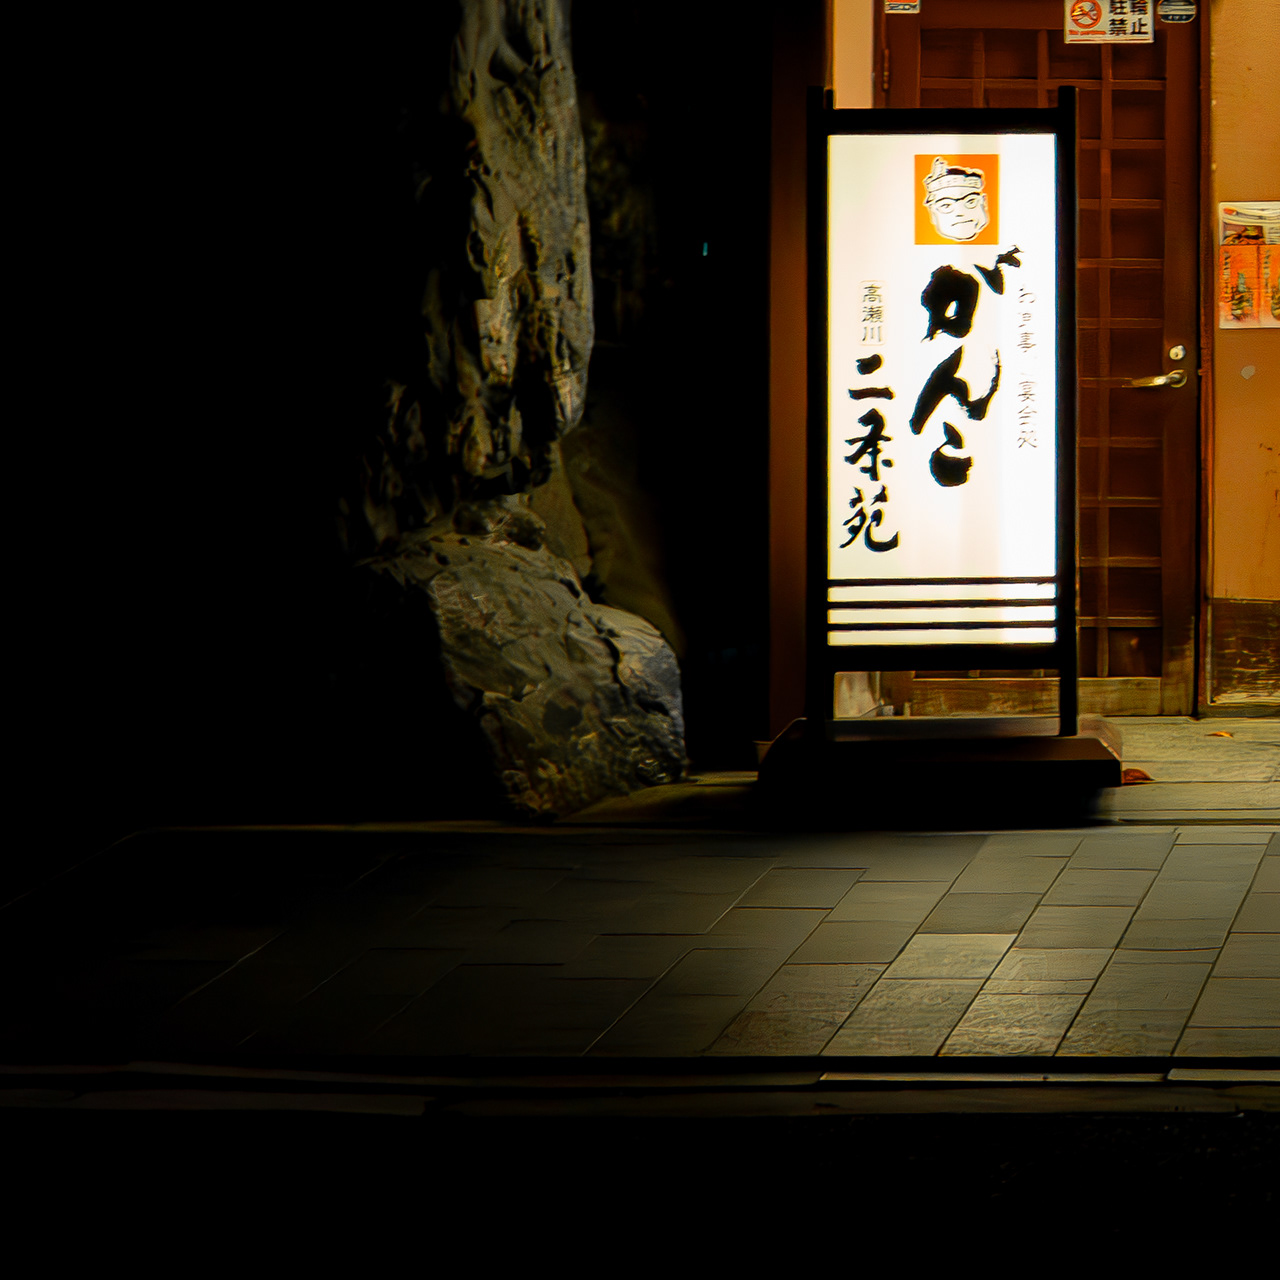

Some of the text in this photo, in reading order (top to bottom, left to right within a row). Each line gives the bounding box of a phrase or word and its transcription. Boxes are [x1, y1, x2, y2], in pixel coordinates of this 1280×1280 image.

[1108, 18, 1149, 36] 禁止
[861, 283, 884, 342] 高瀬川
[909, 245, 1023, 487] がんこ
[839, 354, 900, 552] 二条苑
